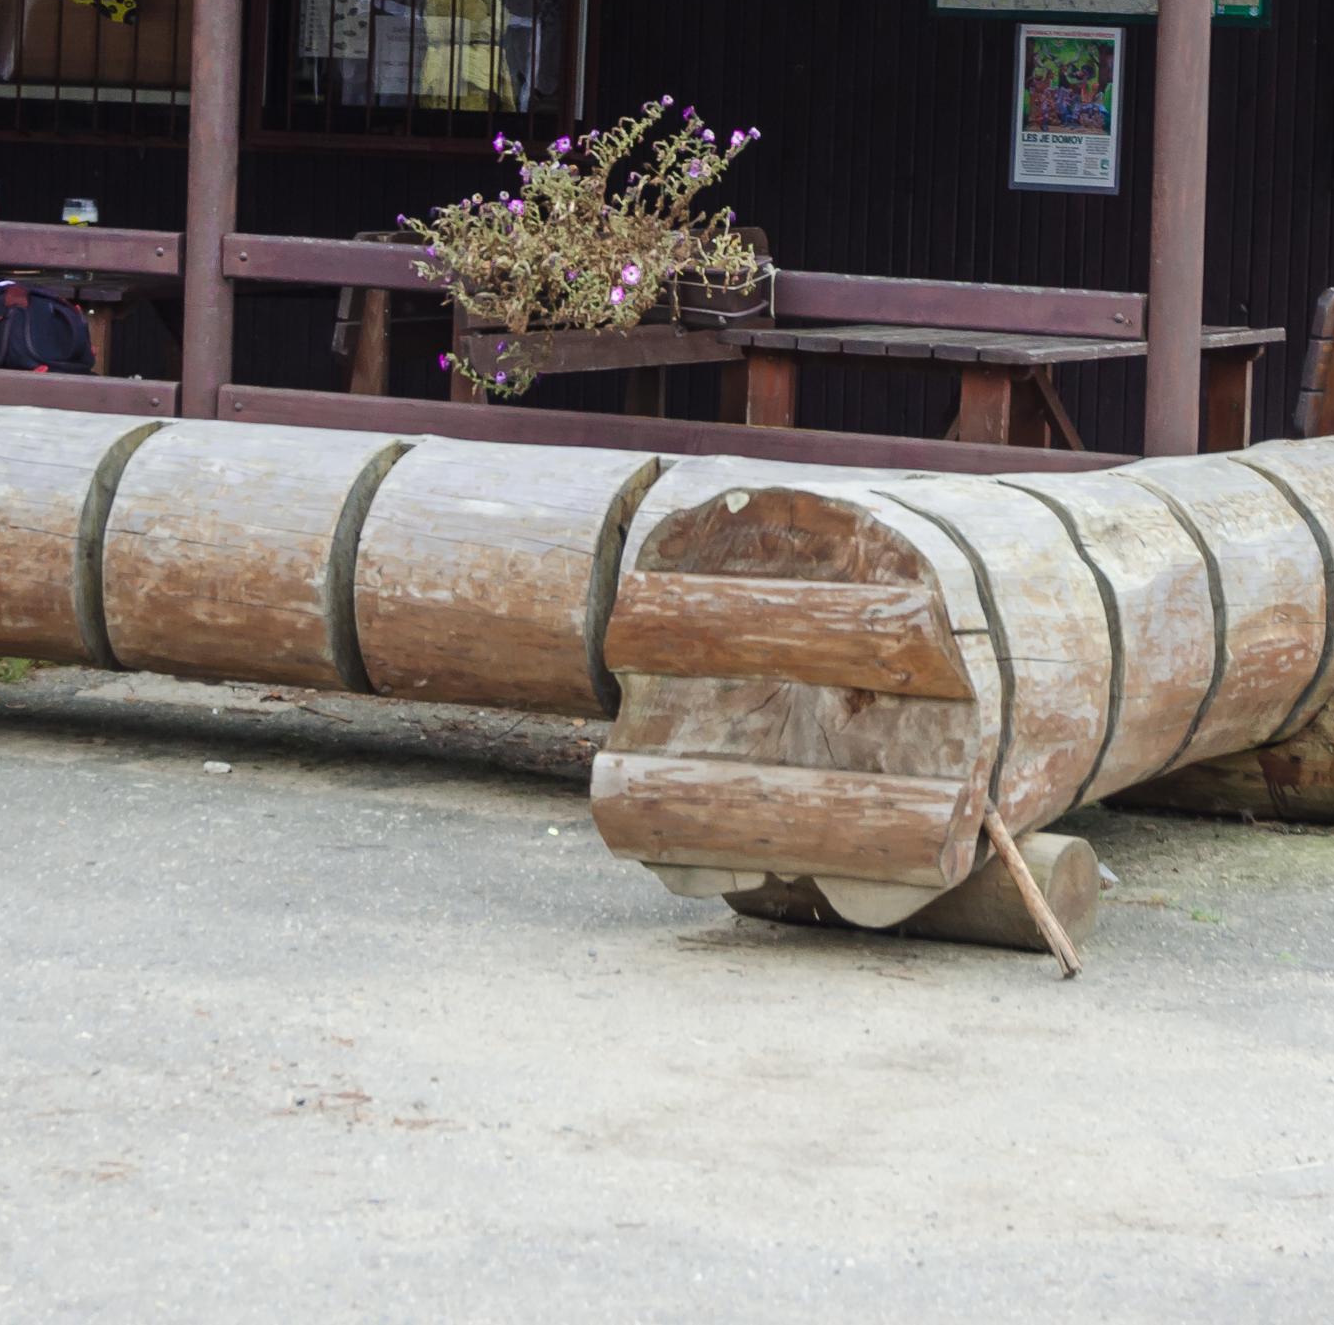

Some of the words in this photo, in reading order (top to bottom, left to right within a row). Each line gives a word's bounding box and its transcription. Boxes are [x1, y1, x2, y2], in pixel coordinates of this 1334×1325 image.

[1021, 133, 1038, 143] LES
[1039, 134, 1050, 144] JE
[1051, 135, 1084, 145] DOMOV
